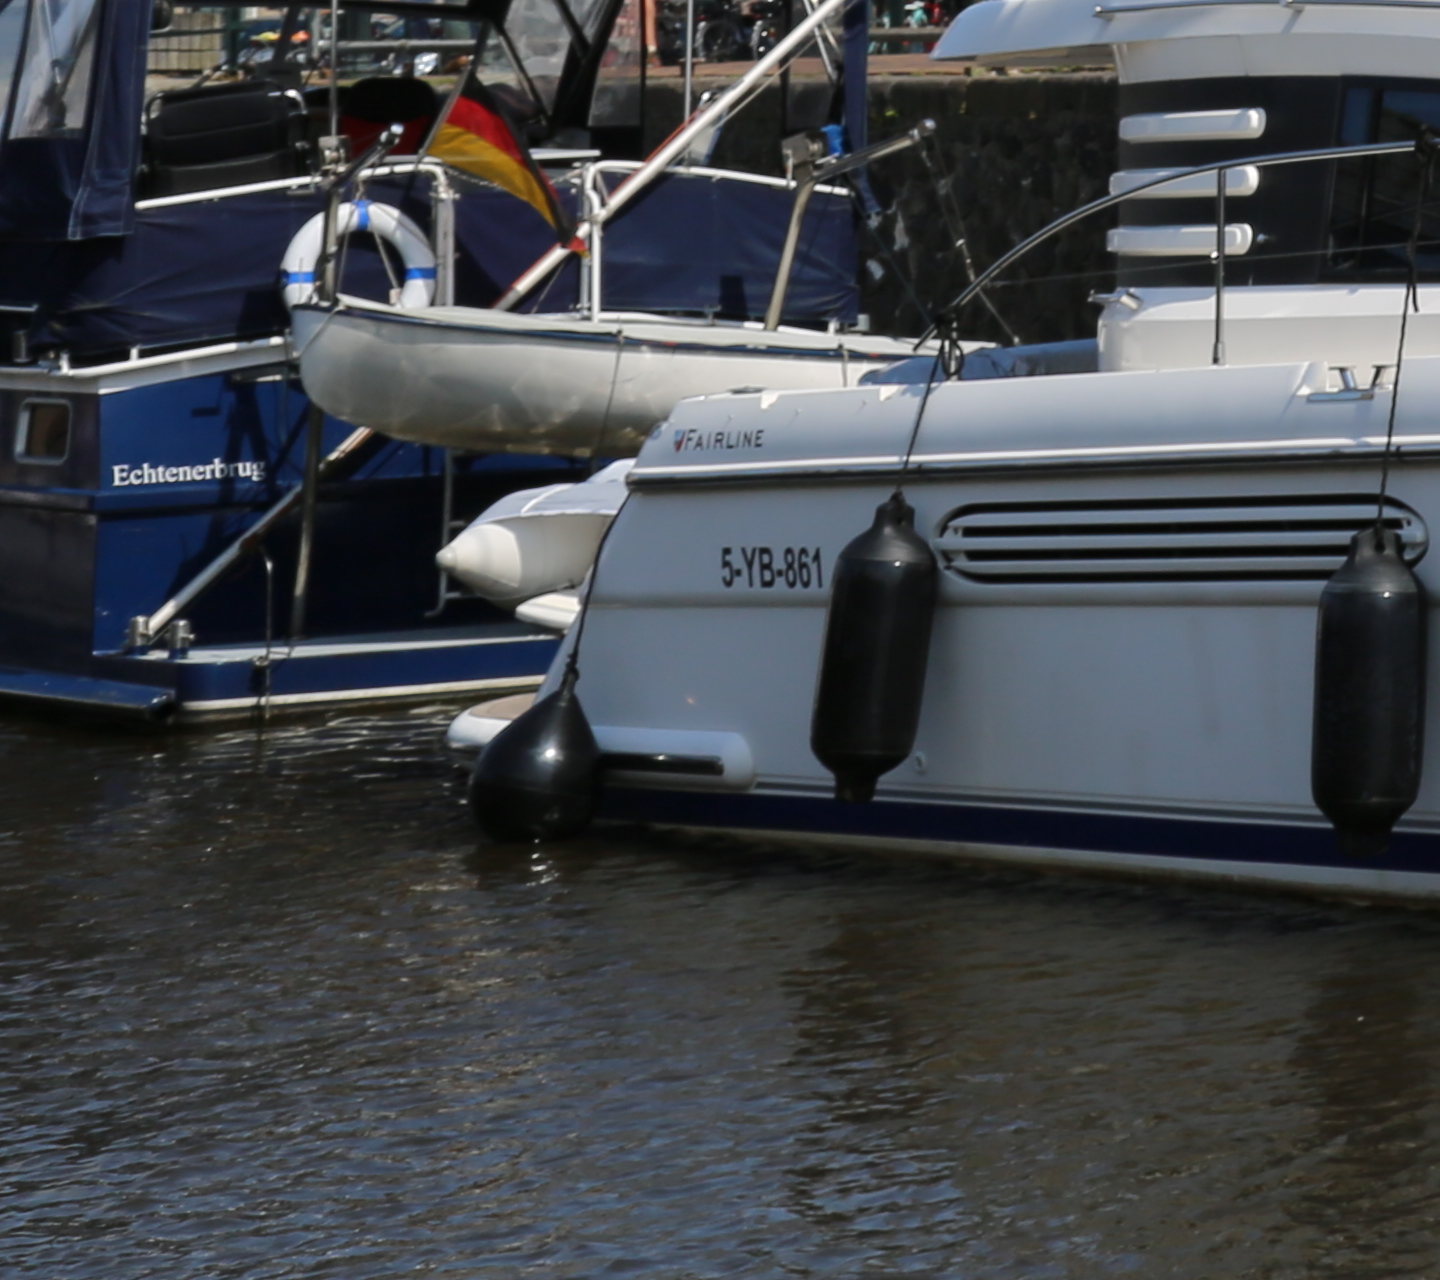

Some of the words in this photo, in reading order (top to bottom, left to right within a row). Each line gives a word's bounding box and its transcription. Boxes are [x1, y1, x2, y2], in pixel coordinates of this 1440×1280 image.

[685, 429, 764, 451] FAIRLINE
[112, 457, 265, 487] Echtenerbrug
[721, 547, 823, 589] 5-YB-861
